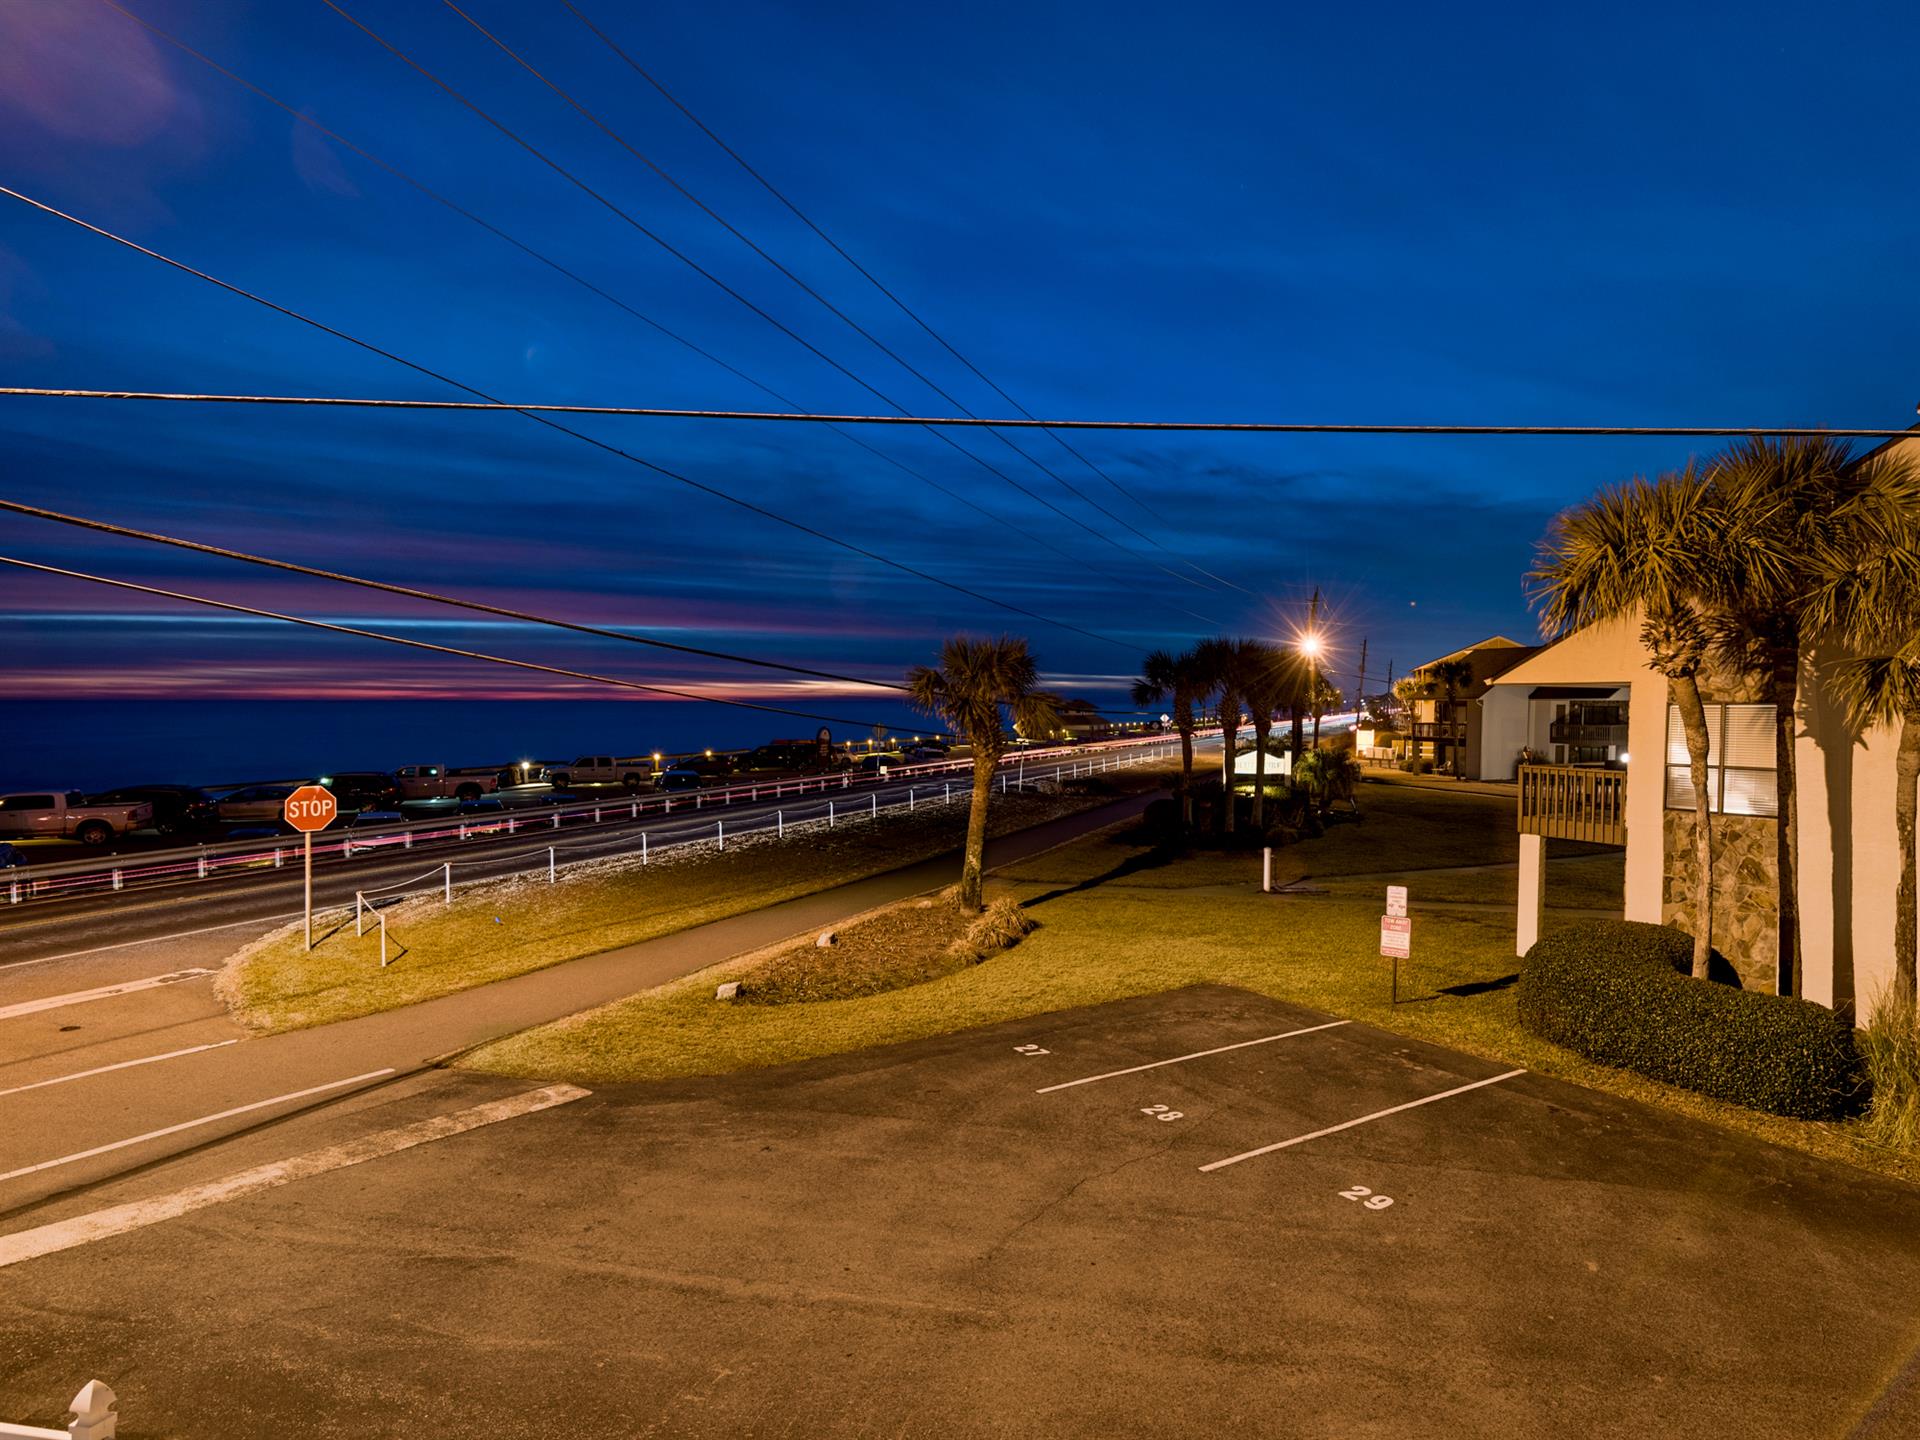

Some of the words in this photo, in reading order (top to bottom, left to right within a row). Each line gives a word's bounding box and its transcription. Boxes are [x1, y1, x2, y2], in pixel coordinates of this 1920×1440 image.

[288, 800, 333, 818] STOP
[1140, 1104, 1184, 1121] 28
[1338, 1185, 1394, 1210] 29
